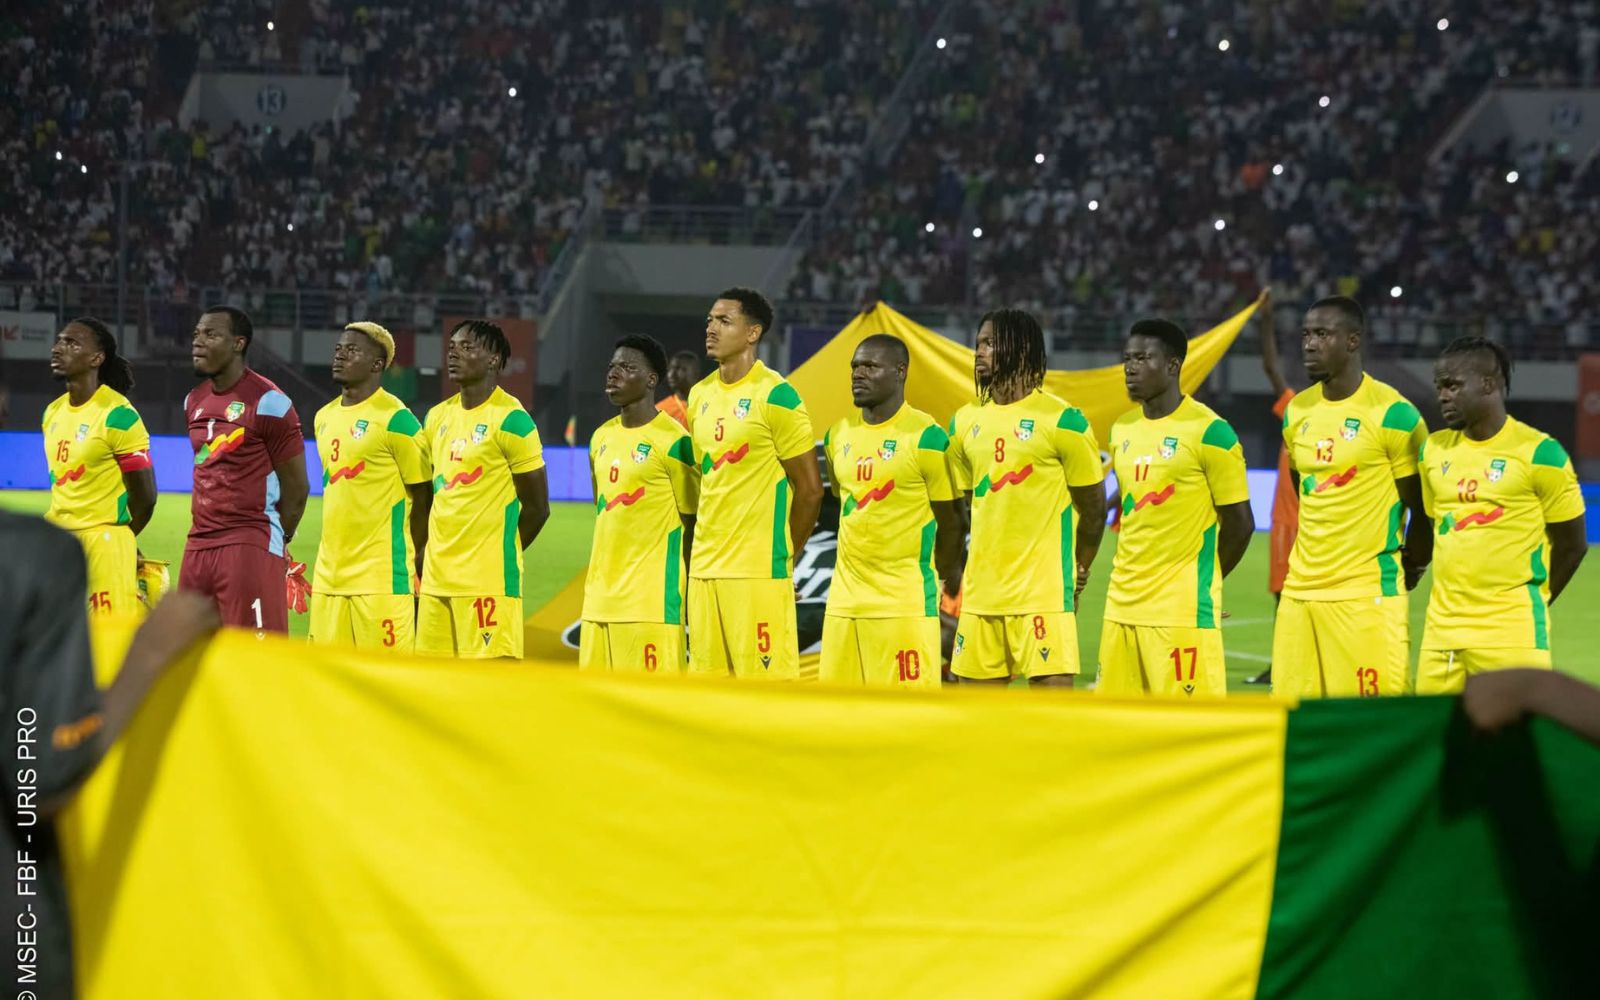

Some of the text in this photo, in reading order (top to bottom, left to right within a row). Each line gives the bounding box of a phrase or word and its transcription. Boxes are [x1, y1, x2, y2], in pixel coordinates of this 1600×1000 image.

[261, 87, 282, 112] 13
[206, 419, 216, 441] 1
[714, 418, 725, 442] 5
[56, 440, 70, 464] 15
[331, 438, 341, 463] 3
[449, 439, 468, 462] 12
[994, 437, 1005, 464] 8
[1315, 438, 1334, 463] 13
[609, 459, 620, 484] 6
[856, 457, 873, 481] 10
[1134, 456, 1152, 481] 17
[1457, 478, 1479, 504] 18
[89, 591, 113, 614] 15
[251, 599, 263, 629] 1
[473, 596, 498, 630] 12
[382, 618, 397, 648] 3
[757, 622, 771, 653] 5
[1033, 615, 1047, 640] 8
[643, 643, 657, 672] 6
[895, 649, 920, 682] 10
[1170, 646, 1199, 682] 17
[1355, 667, 1379, 695] 13
